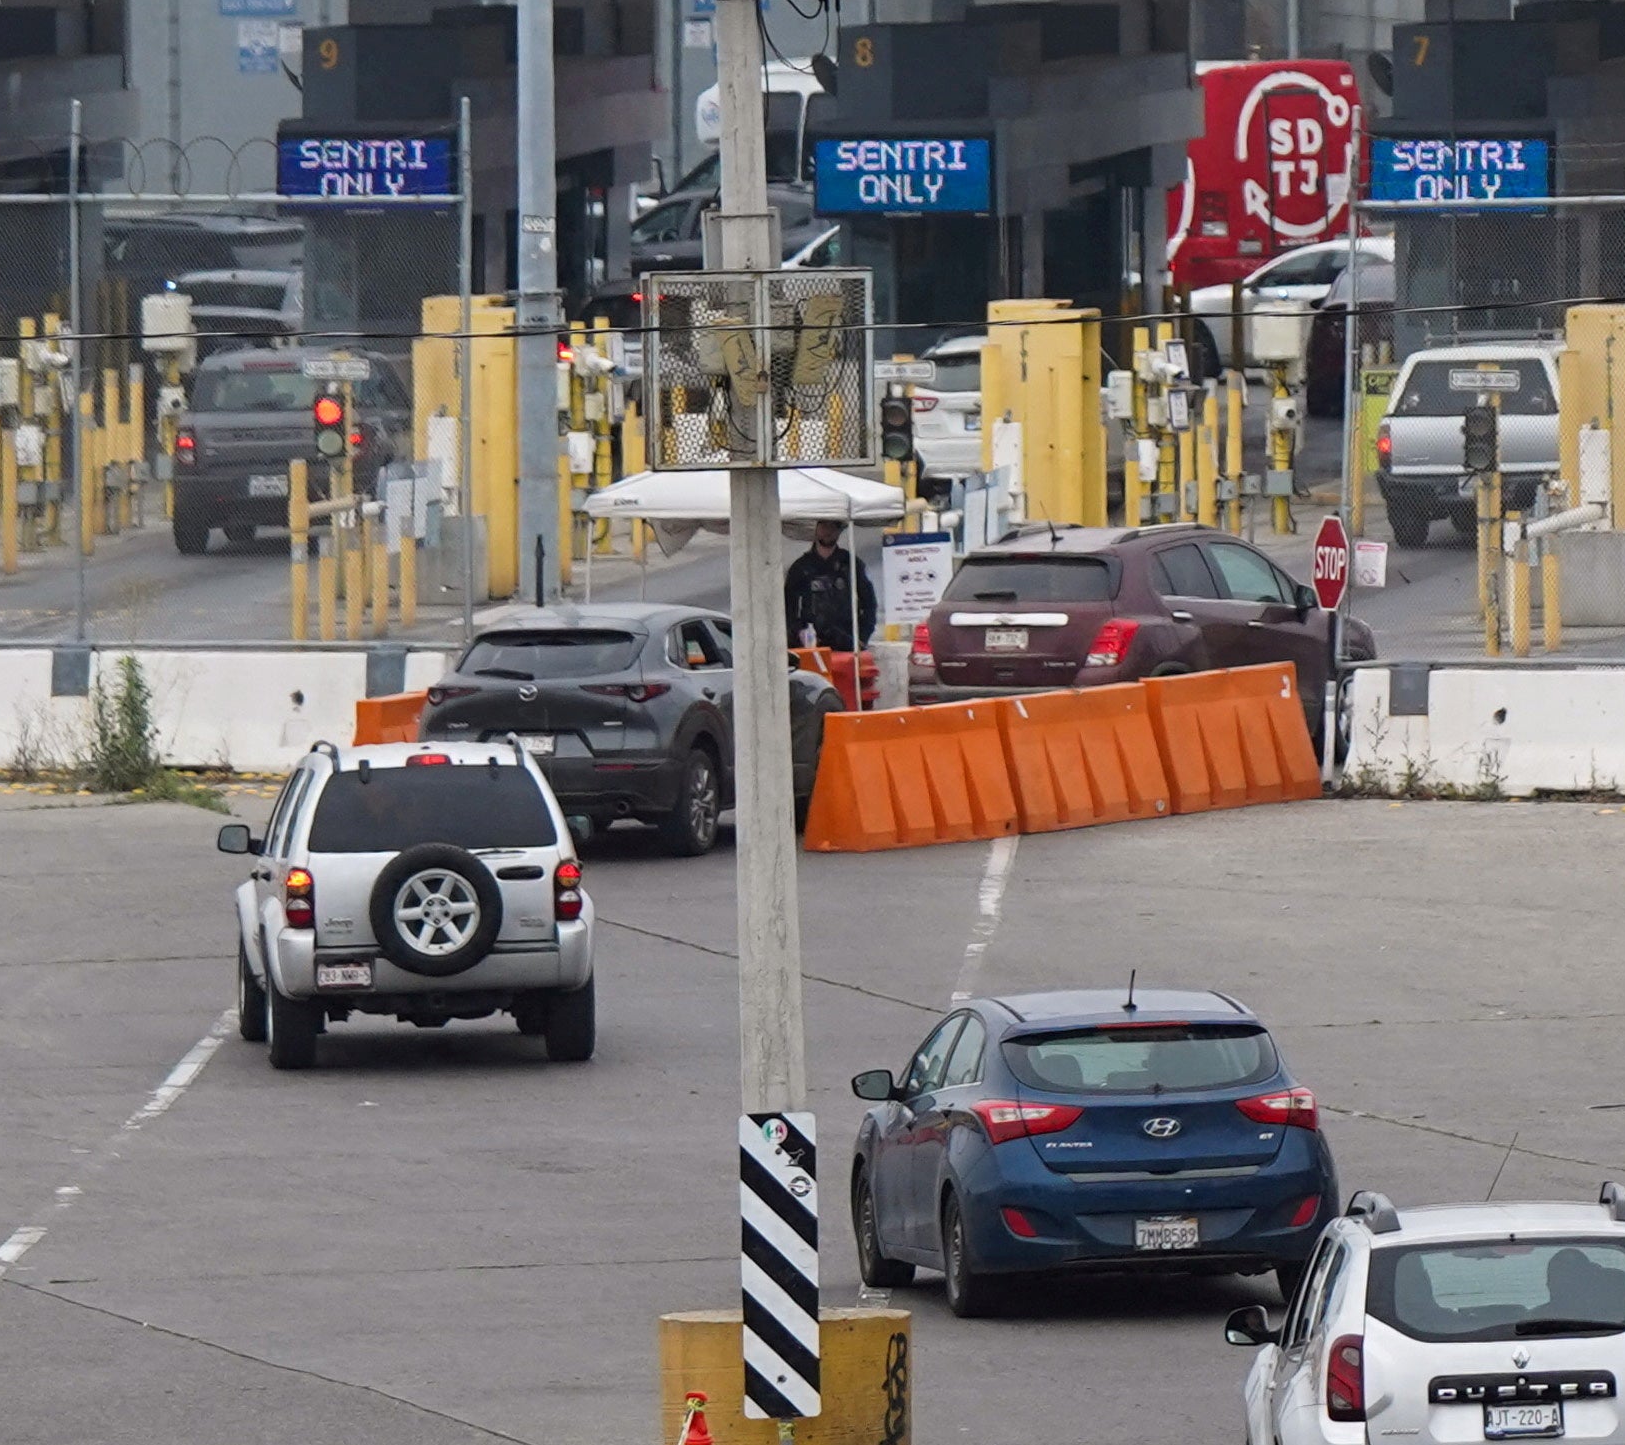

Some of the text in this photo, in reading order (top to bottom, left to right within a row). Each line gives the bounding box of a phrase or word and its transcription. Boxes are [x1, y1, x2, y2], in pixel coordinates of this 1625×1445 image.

[319, 39, 339, 70] 9
[854, 38, 875, 67] 8
[1413, 37, 1431, 67] 7
[1270, 117, 1324, 156] SD
[300, 140, 426, 170] SENTRI
[836, 140, 967, 171] SENTRI
[1392, 141, 1526, 171] SENTRI
[320, 174, 406, 197] ONLY
[859, 174, 943, 205] ONLY
[1271, 159, 1319, 197] TJ
[1315, 546, 1346, 581] STOP
[1437, 1386, 1609, 1400] DUSTER
[1486, 1405, 1561, 1430] AJT-220-A
